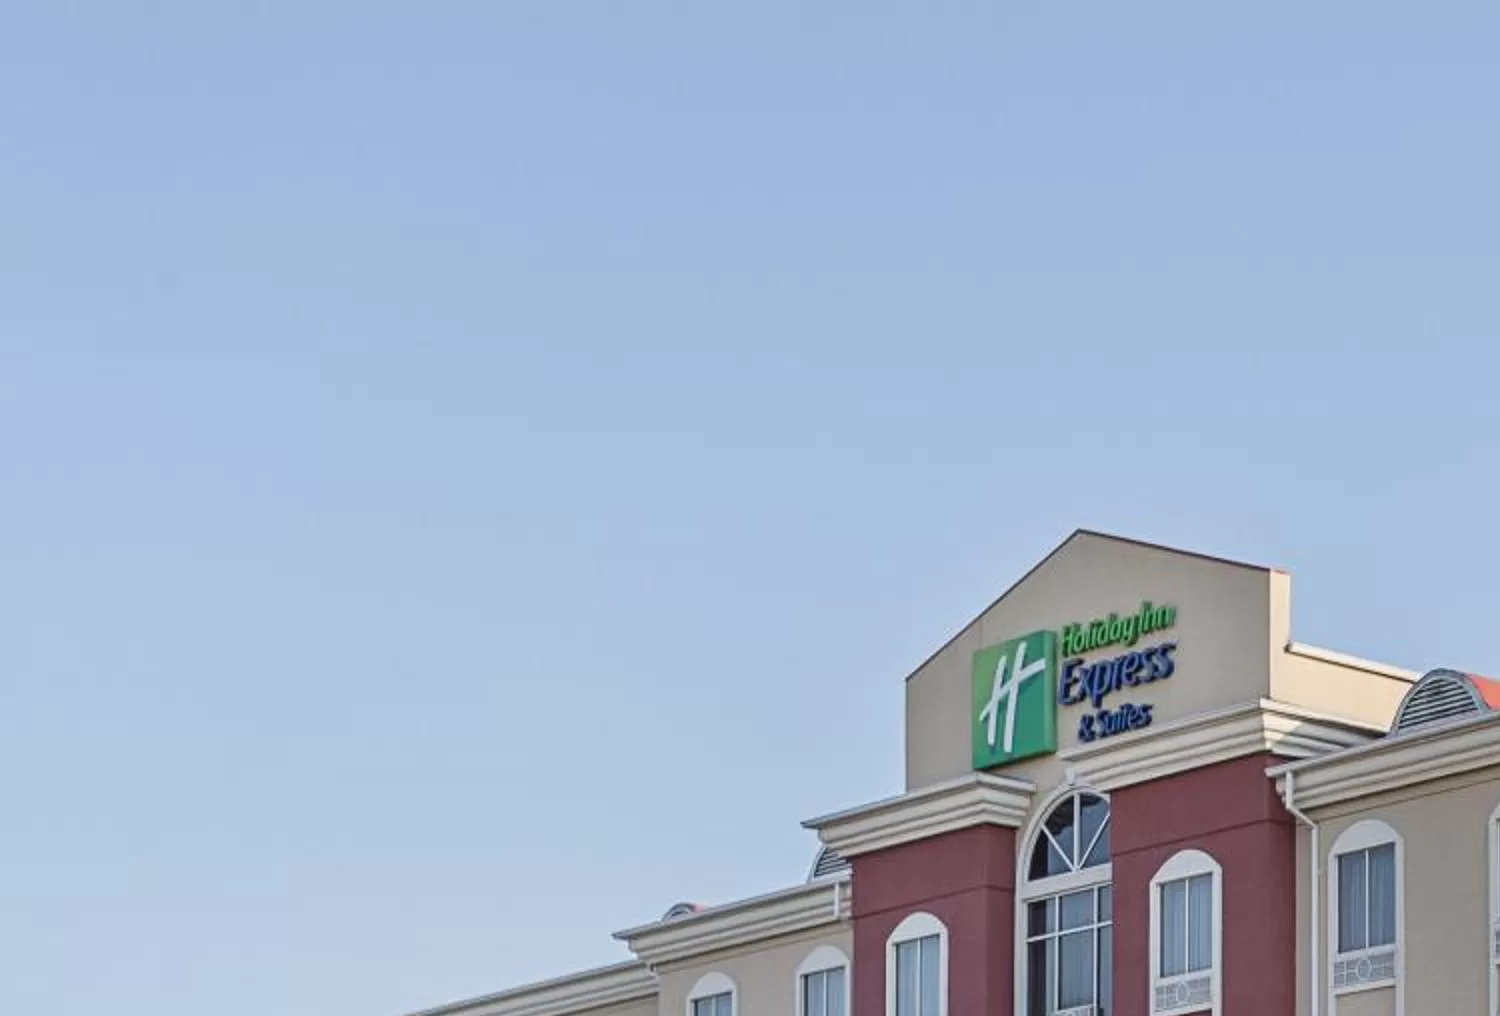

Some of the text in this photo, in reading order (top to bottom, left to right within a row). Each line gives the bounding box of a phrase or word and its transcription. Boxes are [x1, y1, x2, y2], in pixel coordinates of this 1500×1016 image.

[1061, 612, 1140, 657] Holiday
[1057, 640, 1178, 708] Express
[1078, 702, 1155, 744] & Suites
